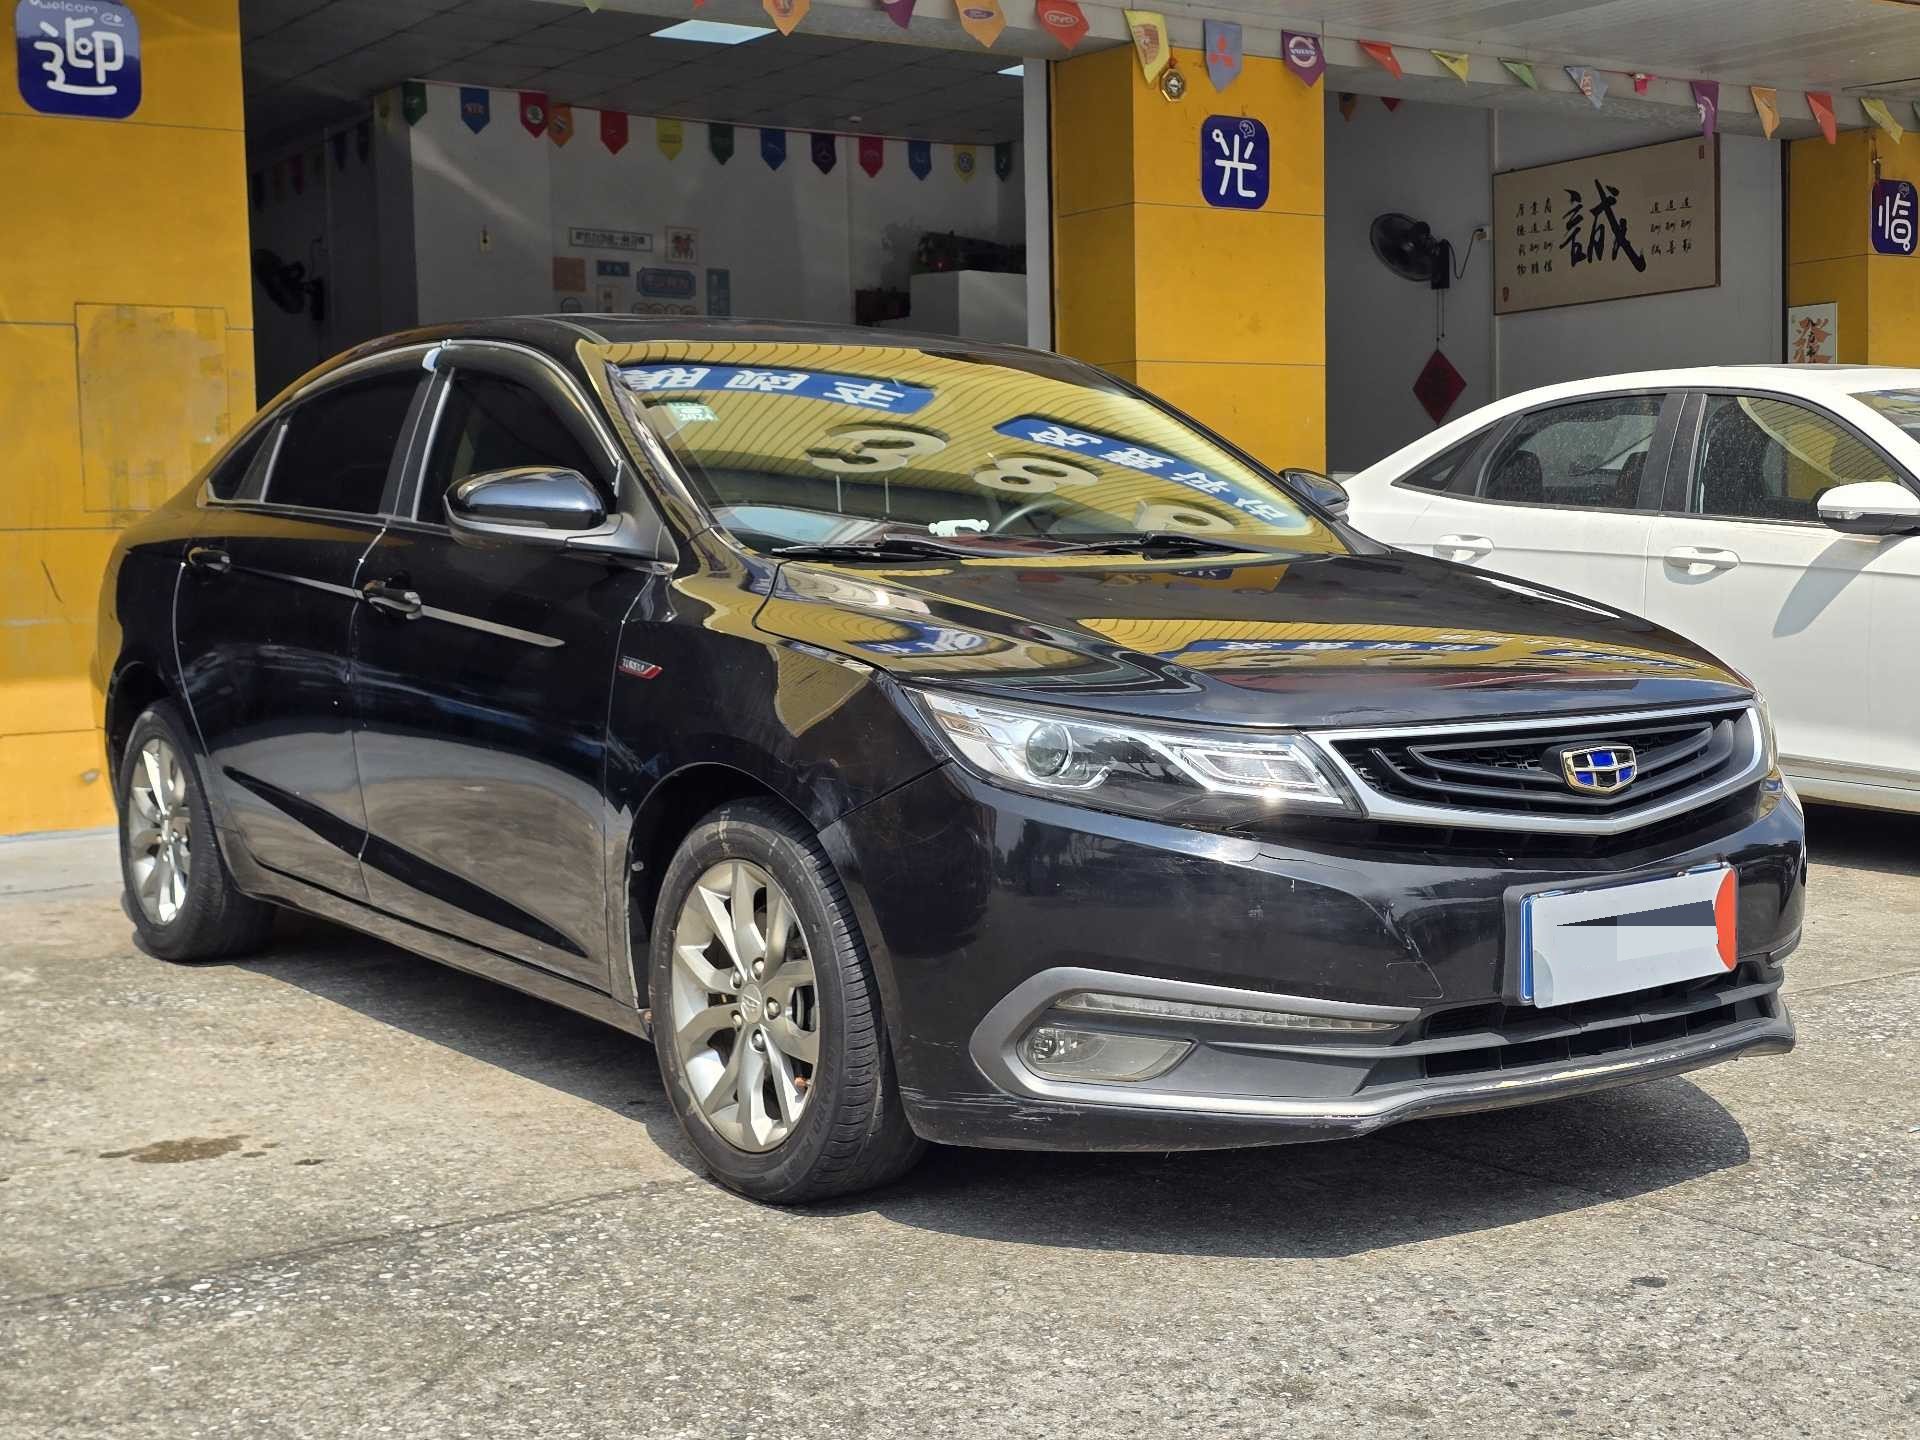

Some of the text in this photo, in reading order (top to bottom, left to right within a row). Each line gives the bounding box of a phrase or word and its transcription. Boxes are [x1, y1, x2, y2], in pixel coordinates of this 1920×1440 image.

[33, 17, 125, 96] 迎
[1211, 128, 1258, 198] 光
[1559, 178, 1647, 273] 誠
